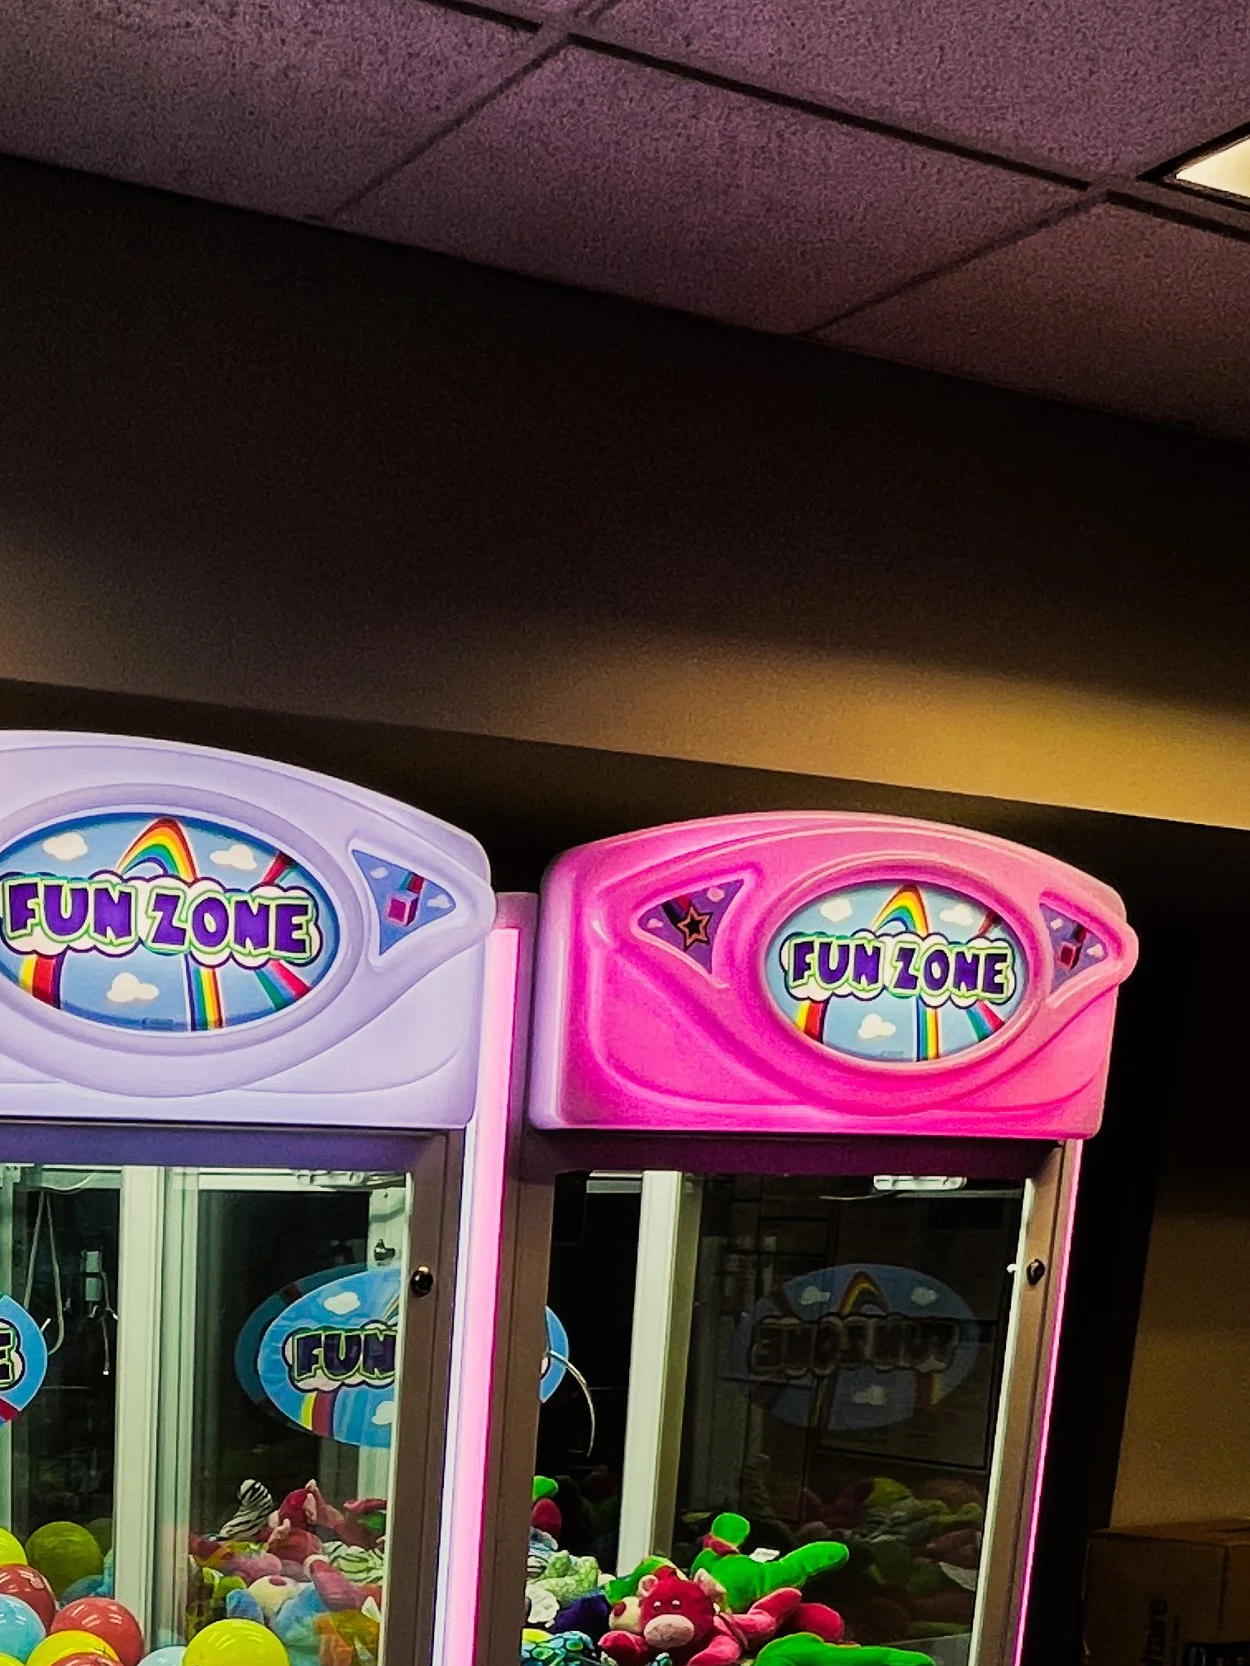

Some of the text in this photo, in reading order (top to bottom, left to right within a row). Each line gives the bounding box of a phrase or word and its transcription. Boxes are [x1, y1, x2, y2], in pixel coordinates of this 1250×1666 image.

[6, 879, 312, 955] FUN ZONE
[790, 938, 1010, 995] FUN ZONE
[295, 1331, 396, 1378] FUN
